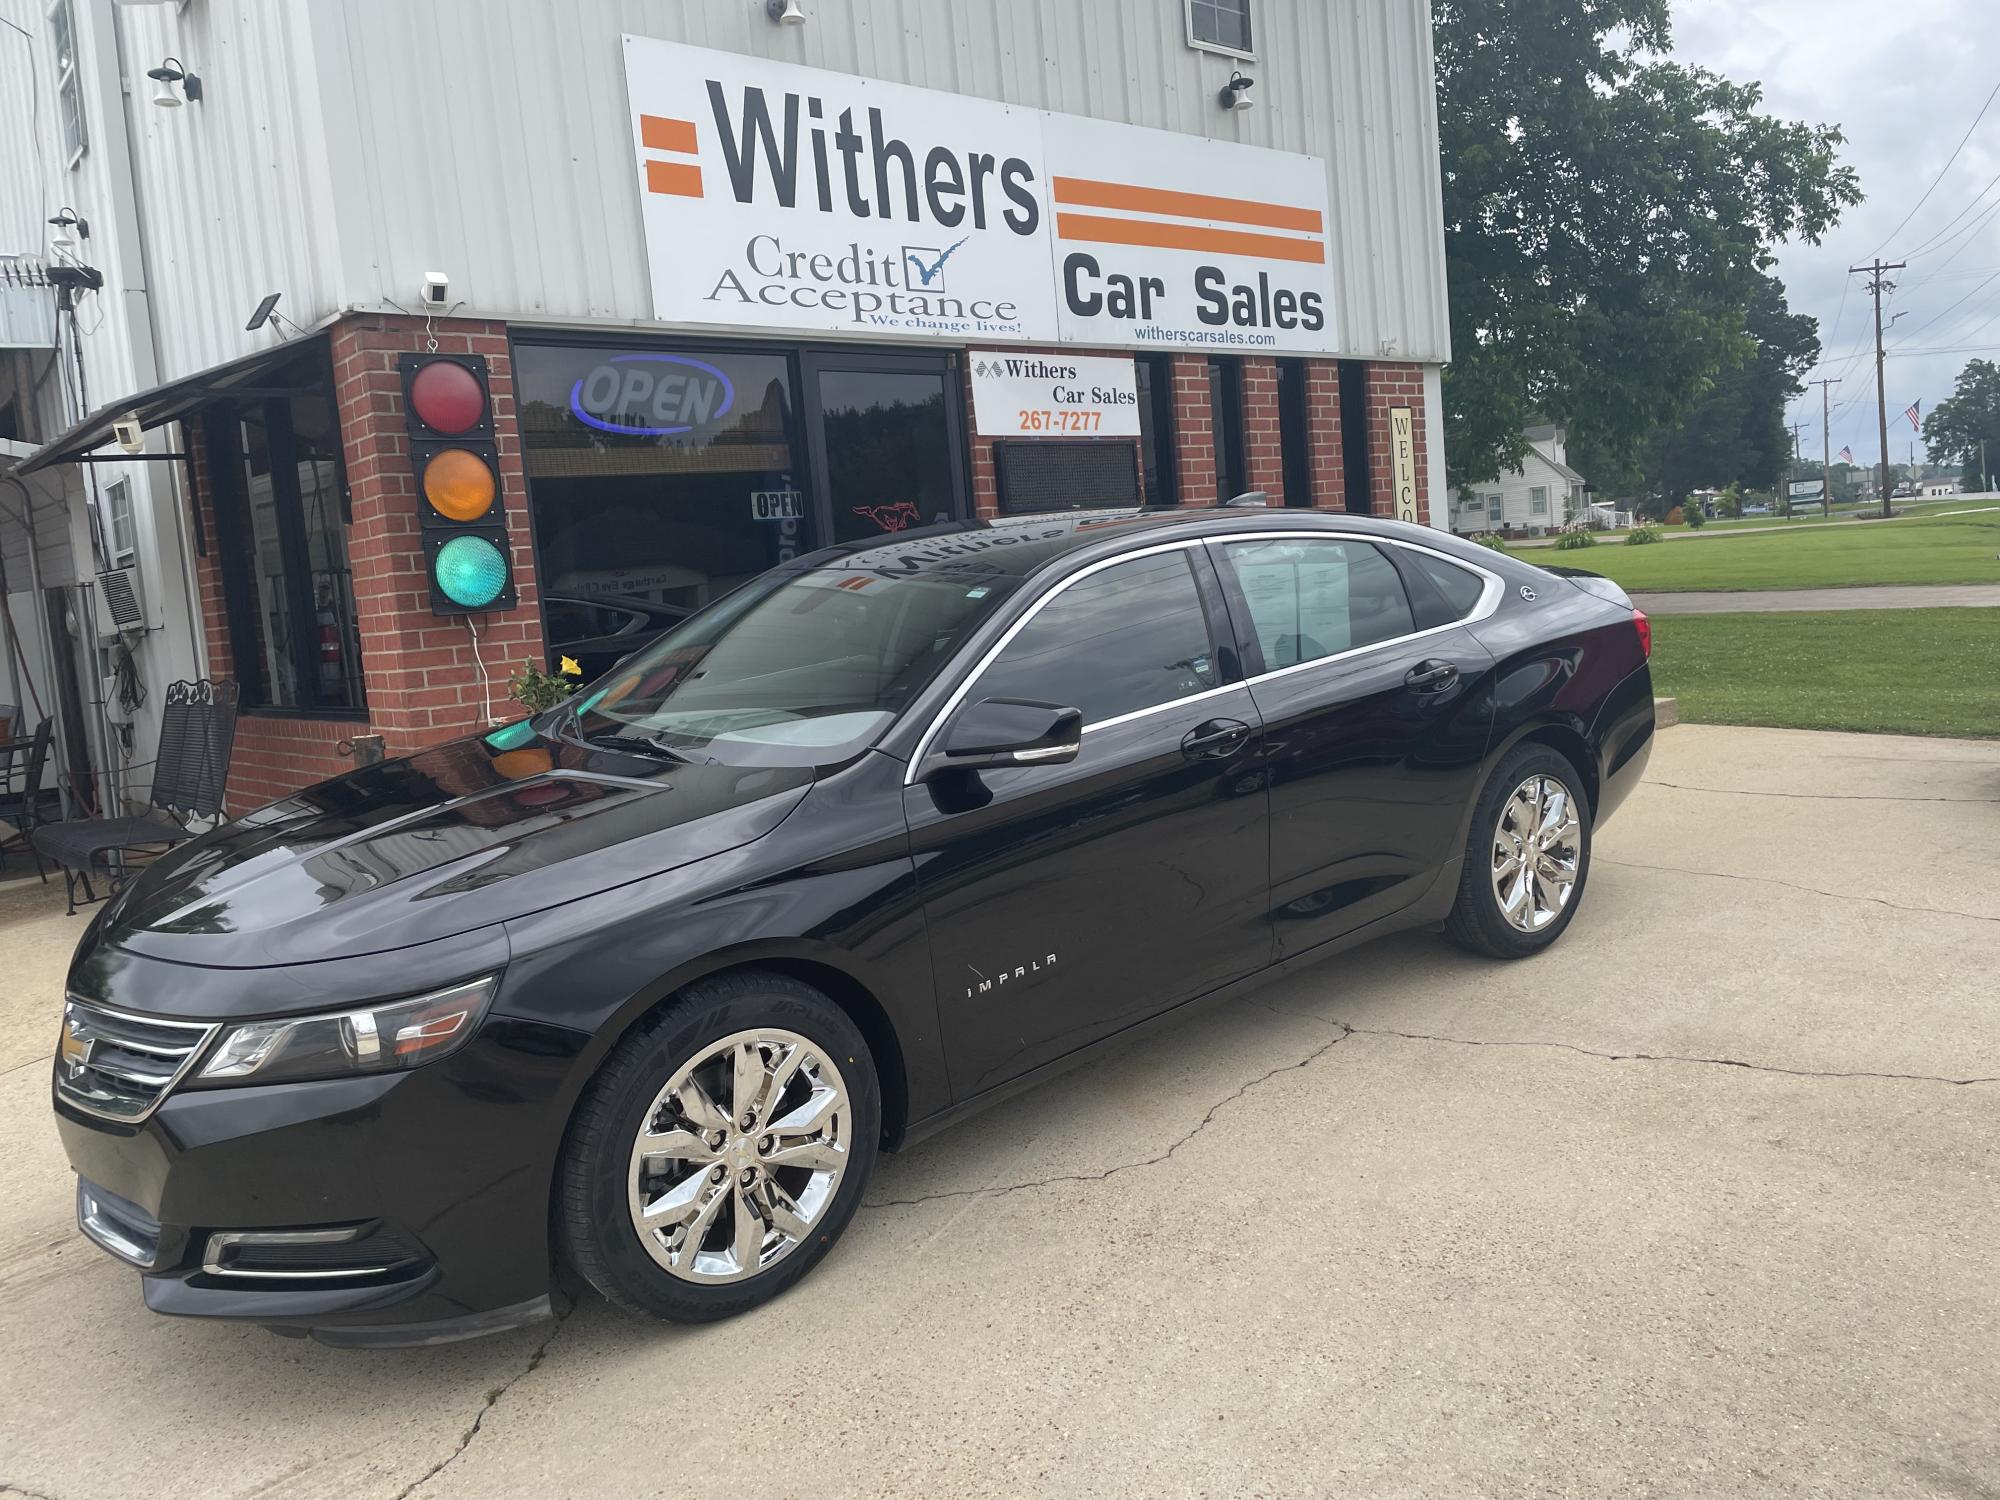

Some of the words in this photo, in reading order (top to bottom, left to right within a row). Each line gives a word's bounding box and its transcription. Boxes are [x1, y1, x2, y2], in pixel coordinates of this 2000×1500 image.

[705, 79, 1040, 236] Withers
[746, 235, 900, 287] Credit
[703, 268, 1017, 323] Acceptance
[1063, 252, 1165, 320] Car
[1194, 266, 1325, 331] Sales
[869, 314, 899, 327] We
[905, 317, 970, 333] change
[977, 321, 1022, 333] lives!
[1134, 325, 1276, 346] witherscarsales.com
[1005, 359, 1077, 379] Withers
[583, 366, 718, 425] OPEN
[1053, 386, 1085, 404] Car
[1092, 387, 1136, 405] Sales
[1019, 410, 1102, 431] 267-7277
[756, 493, 803, 518] OPEN
[967, 953, 1057, 998] IMPALA
